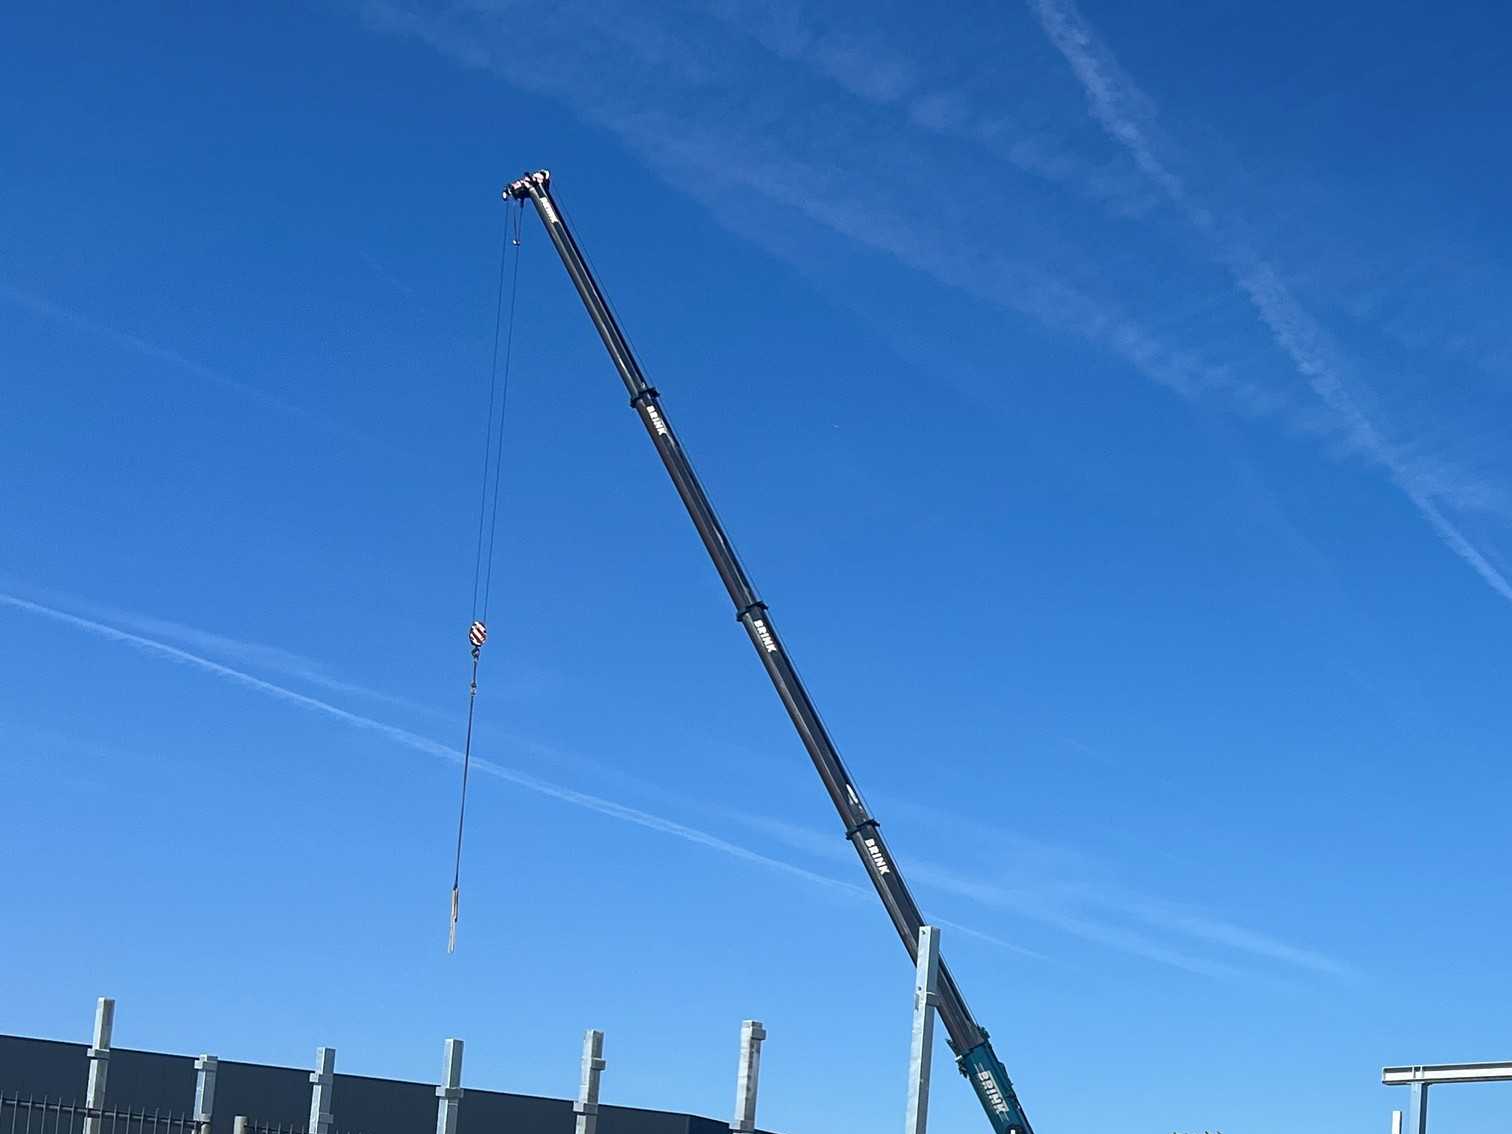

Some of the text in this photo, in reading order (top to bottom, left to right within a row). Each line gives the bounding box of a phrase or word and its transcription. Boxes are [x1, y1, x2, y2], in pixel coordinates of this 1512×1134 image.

[646, 405, 667, 435] BRINK
[754, 619, 777, 653] BRINK
[864, 838, 890, 875] BRINK
[978, 1070, 1009, 1114] BRINK
